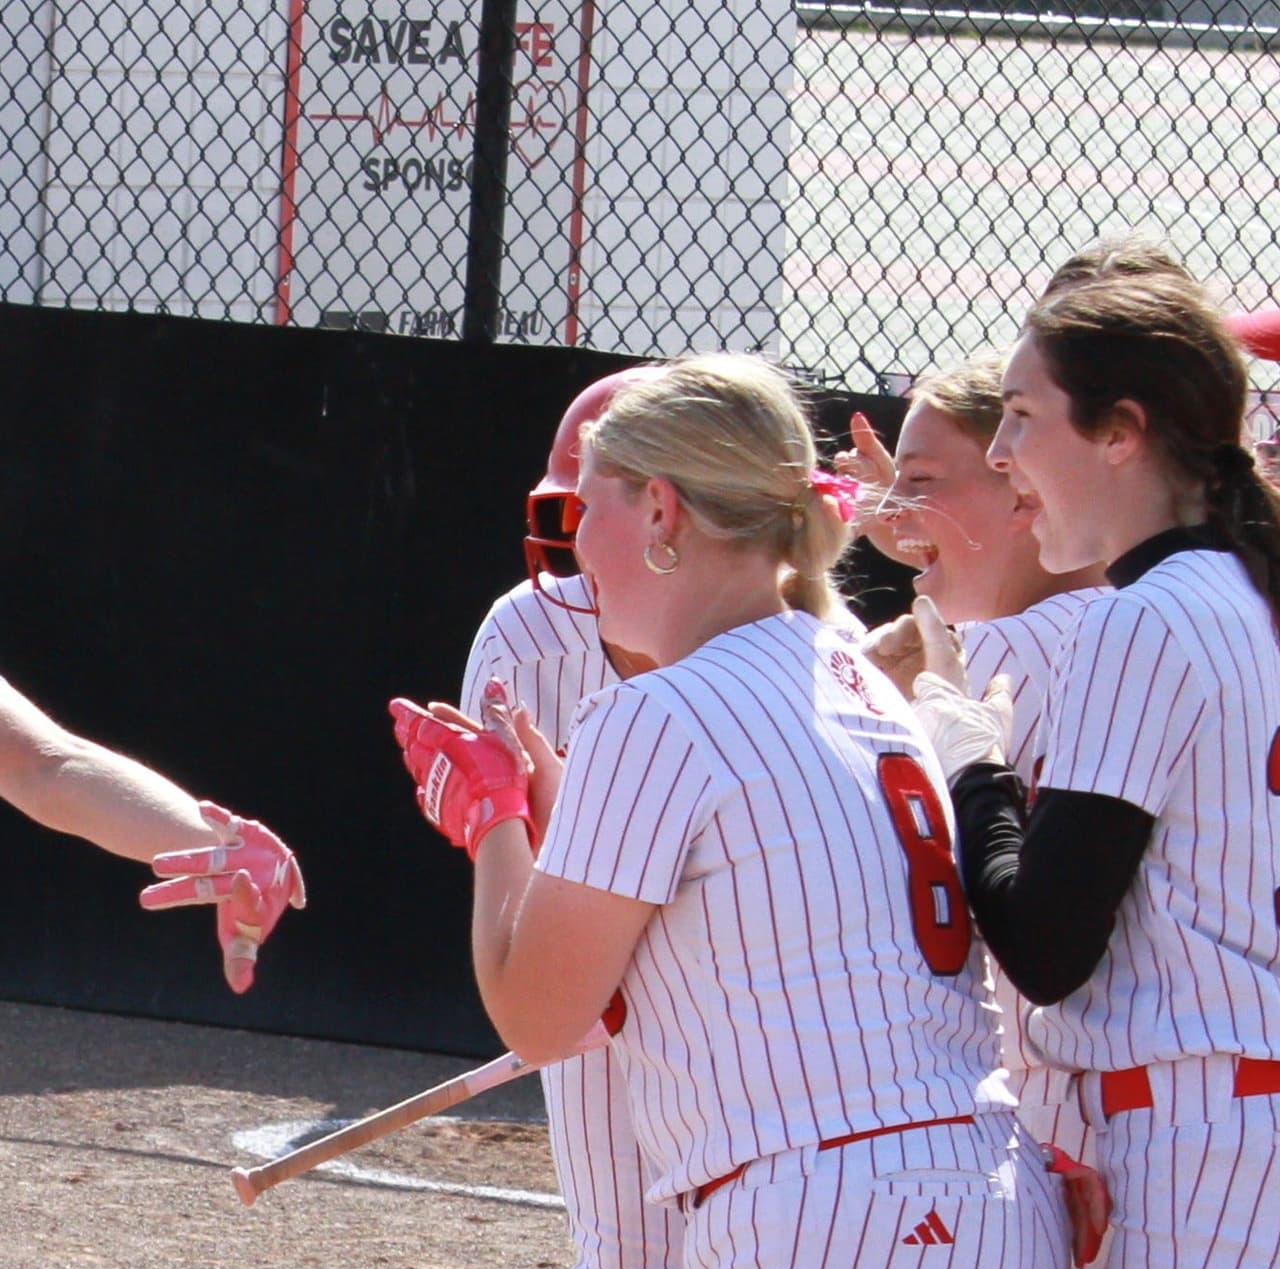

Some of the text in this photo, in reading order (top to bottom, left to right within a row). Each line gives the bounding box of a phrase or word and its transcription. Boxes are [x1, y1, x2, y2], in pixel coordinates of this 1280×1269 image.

[328, 18, 432, 65] SAVE
[438, 20, 466, 65] A
[361, 157, 473, 191] SPONS
[877, 752, 970, 977] 8
